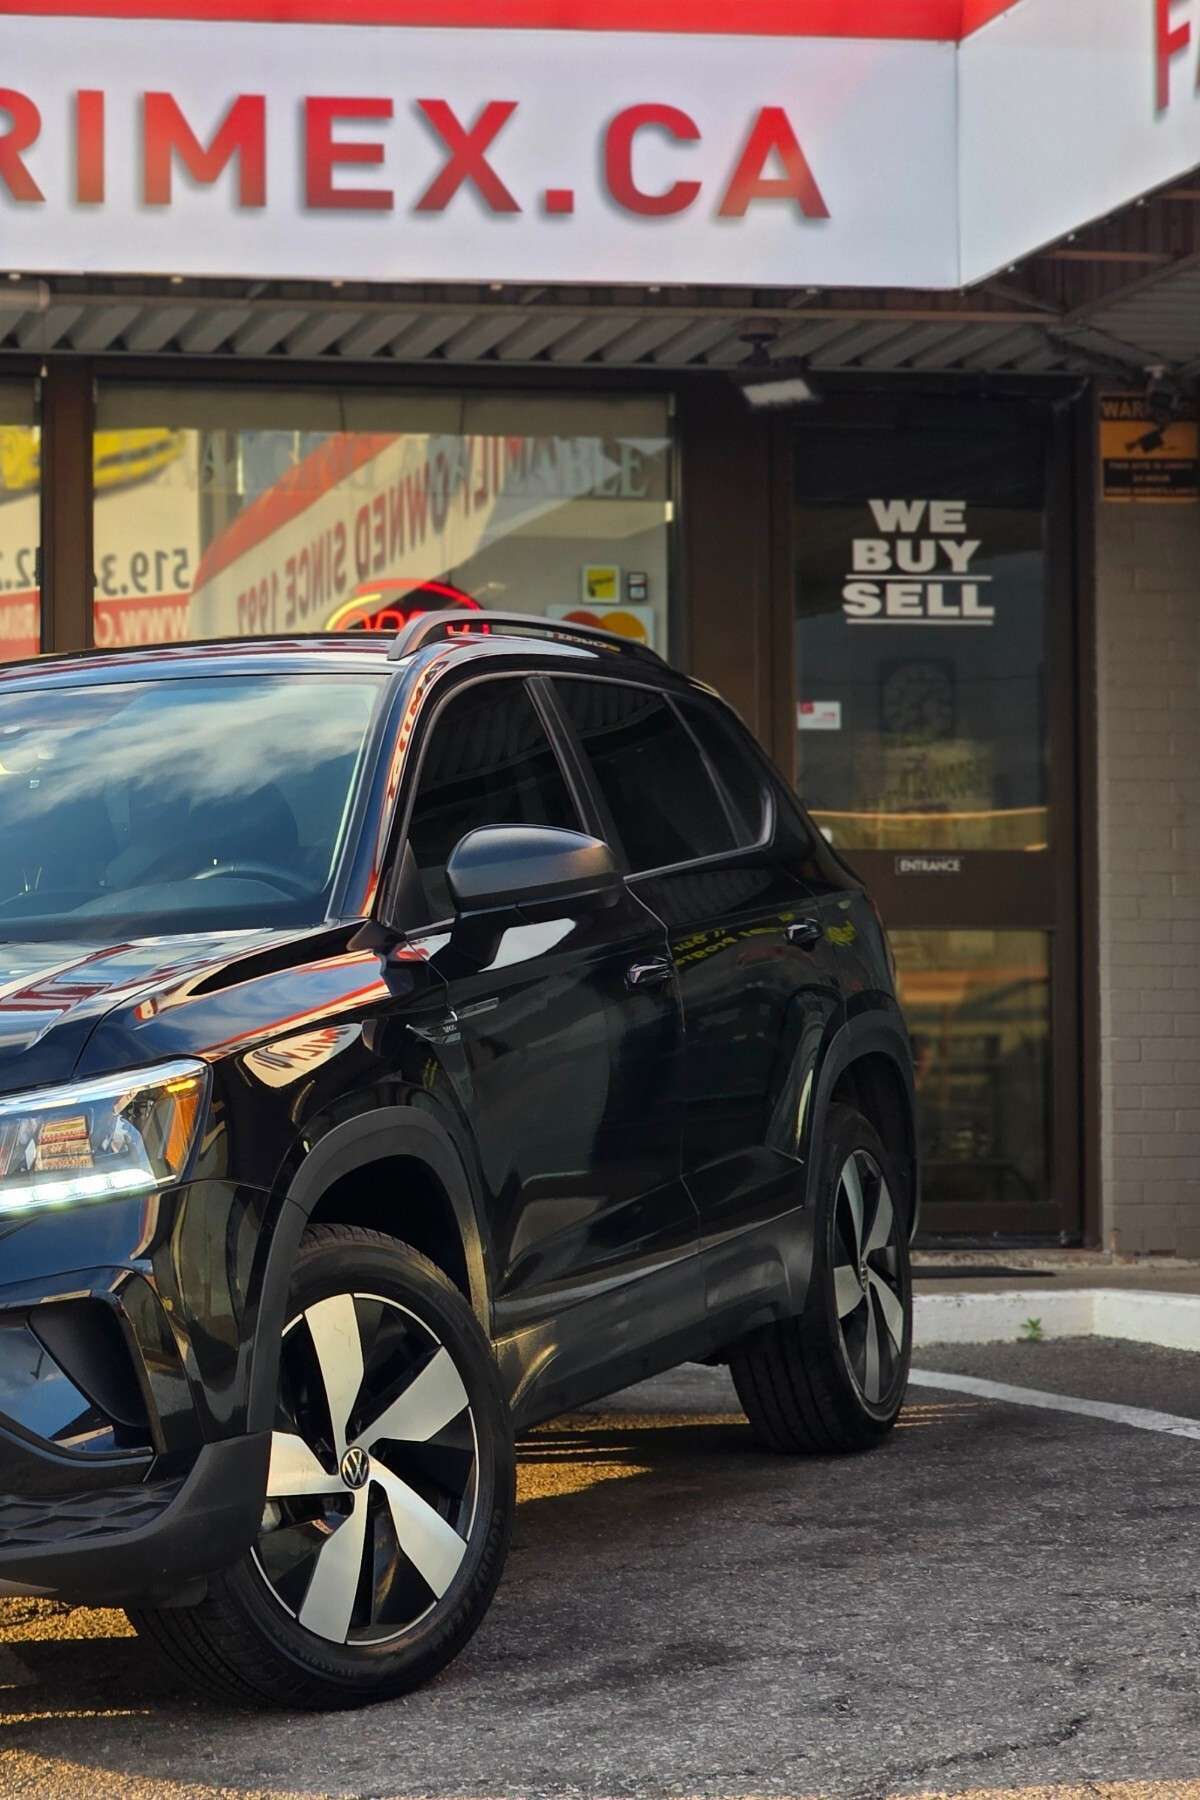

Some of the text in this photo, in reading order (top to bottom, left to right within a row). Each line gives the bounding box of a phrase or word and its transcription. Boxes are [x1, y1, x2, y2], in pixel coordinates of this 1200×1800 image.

[868, 499, 967, 533] WE
[852, 539, 981, 573] BUY
[842, 583, 995, 617] SELL
[900, 859, 961, 872] ENTRANCE
